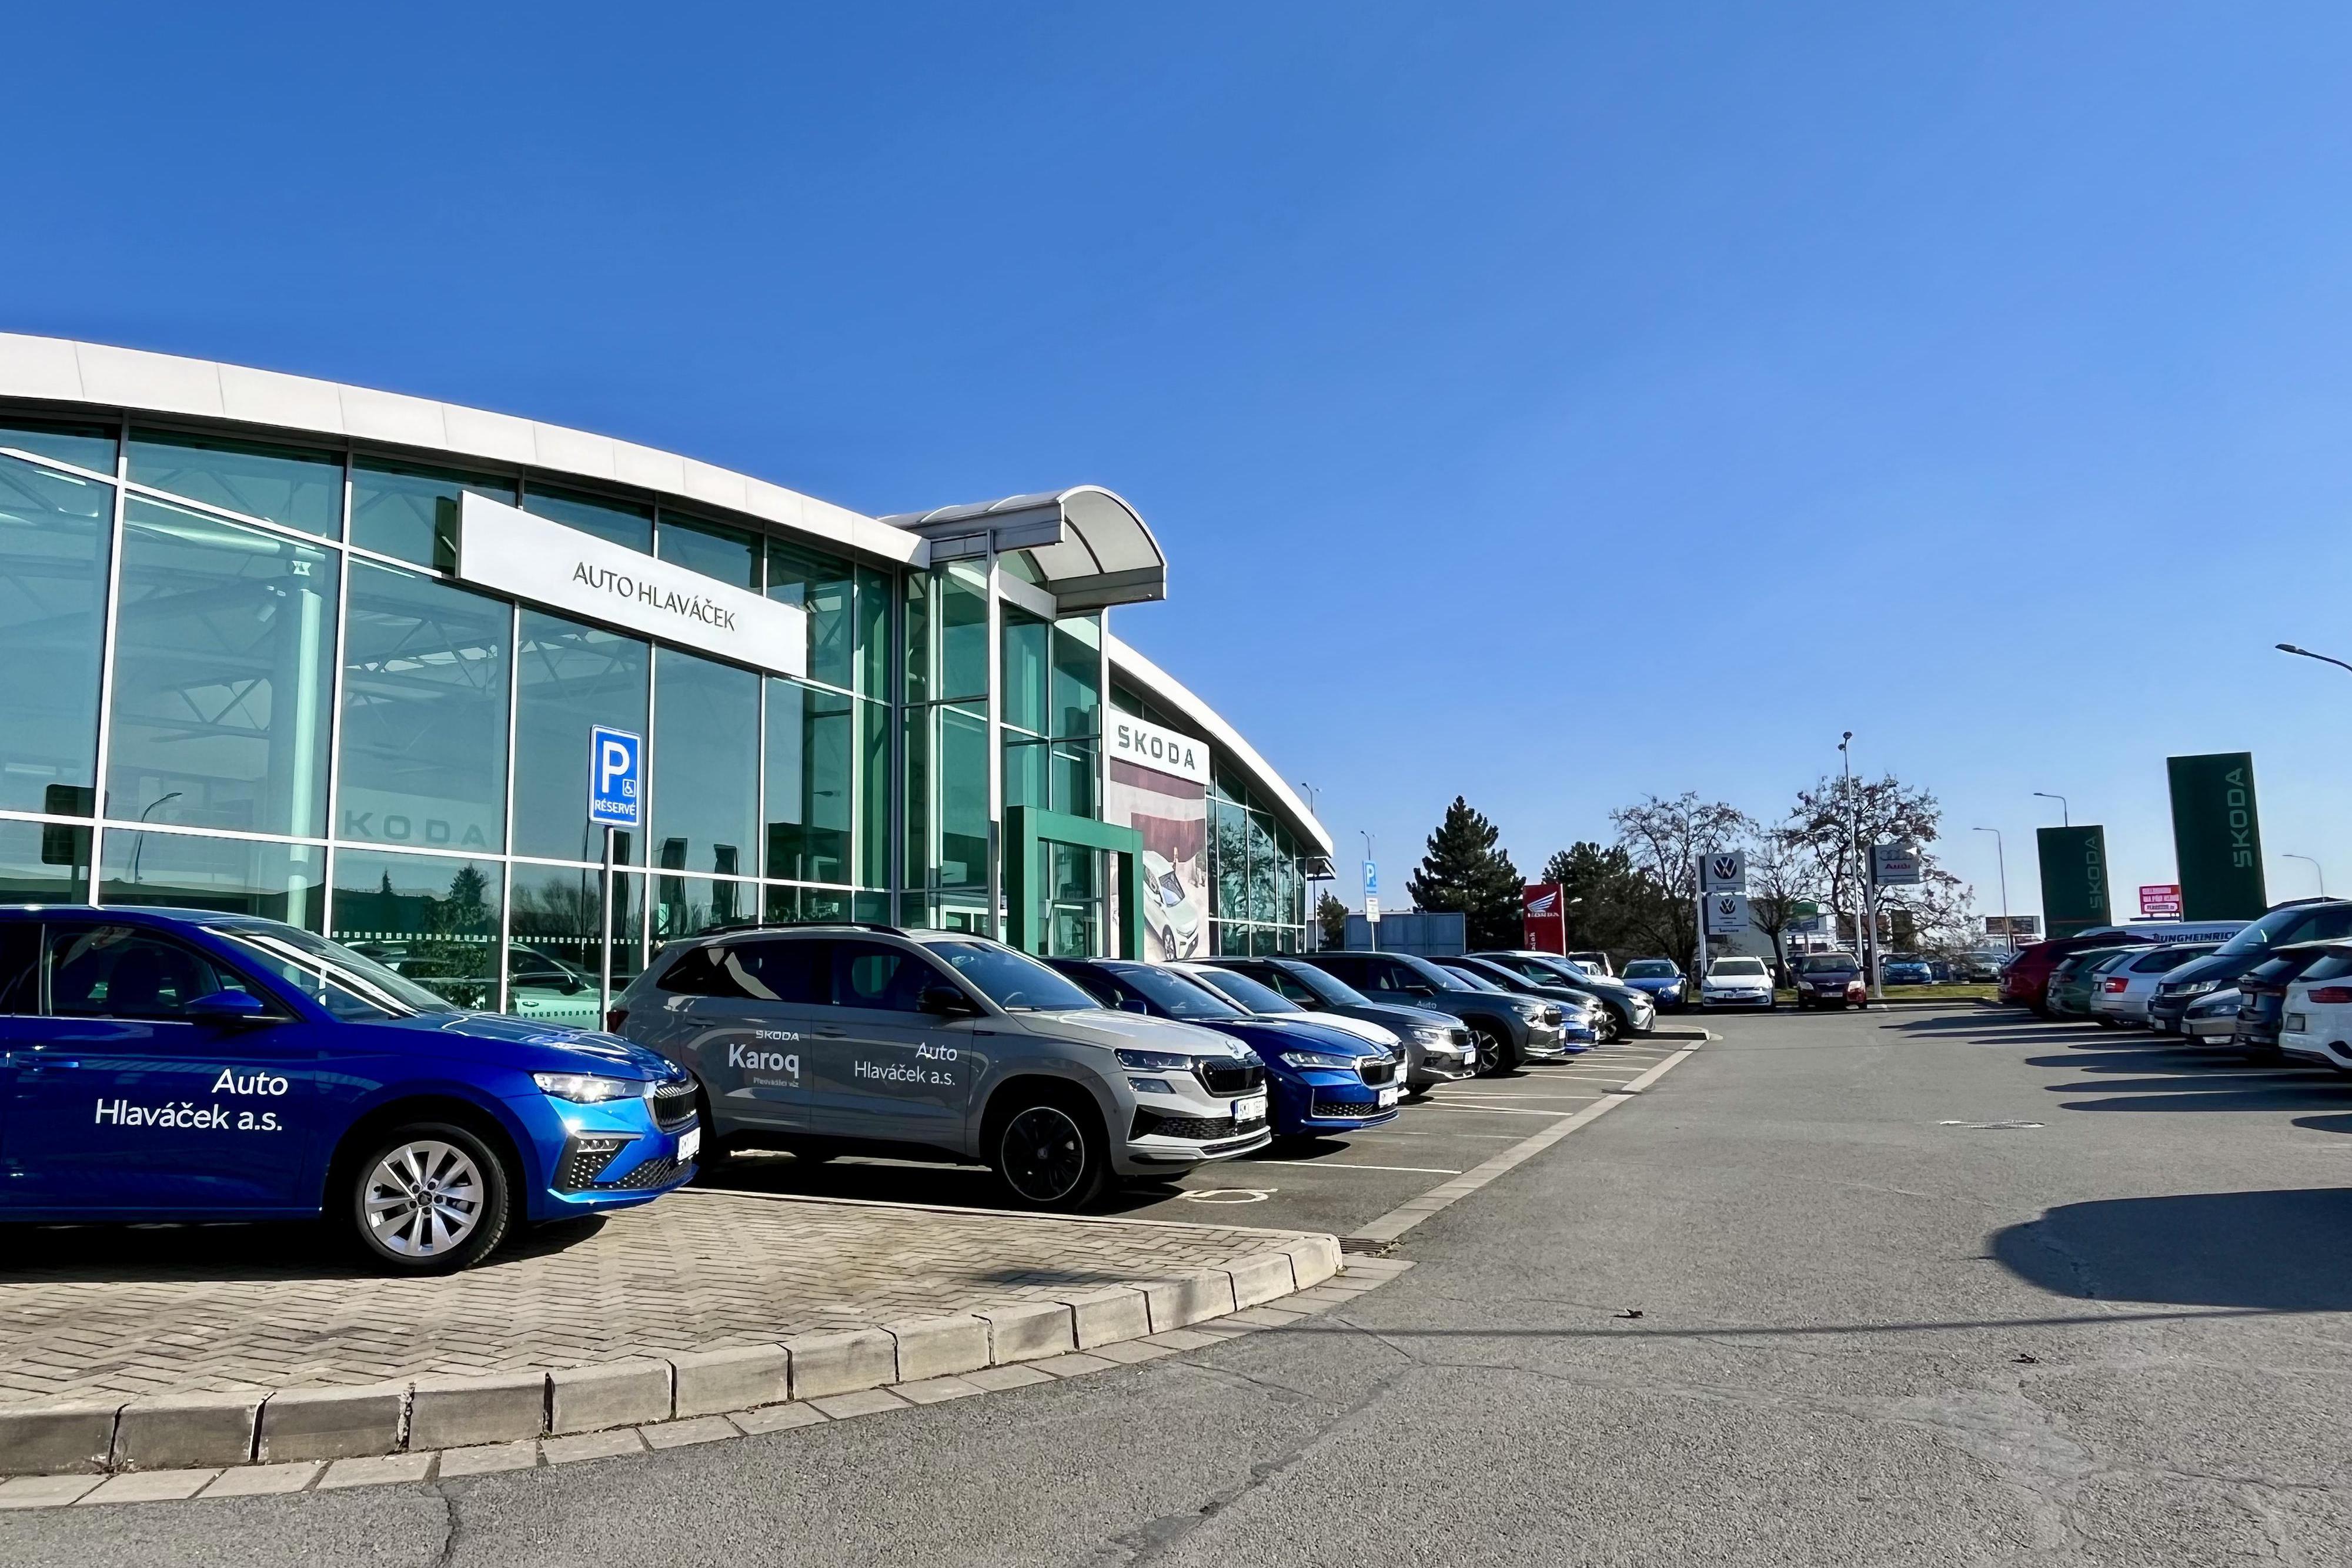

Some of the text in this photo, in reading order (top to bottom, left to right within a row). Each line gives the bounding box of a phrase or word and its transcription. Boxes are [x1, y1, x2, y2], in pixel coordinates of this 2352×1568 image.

[572, 561, 736, 631] AUTO HLAVÁČEK
[602, 740, 630, 794] P
[594, 798, 636, 816] RÉSERVÉ
[343, 809, 488, 848] KODA
[1366, 864, 1375, 886] P
[2152, 931, 2239, 943] JUNGHEINRIC
[729, 1043, 800, 1079] Karoq
[916, 1042, 957, 1061] Auto
[211, 1068, 288, 1096] Auto
[855, 1060, 956, 1086] Hlaváček a.s.
[95, 1098, 283, 1131] Hlaváček a.s.
